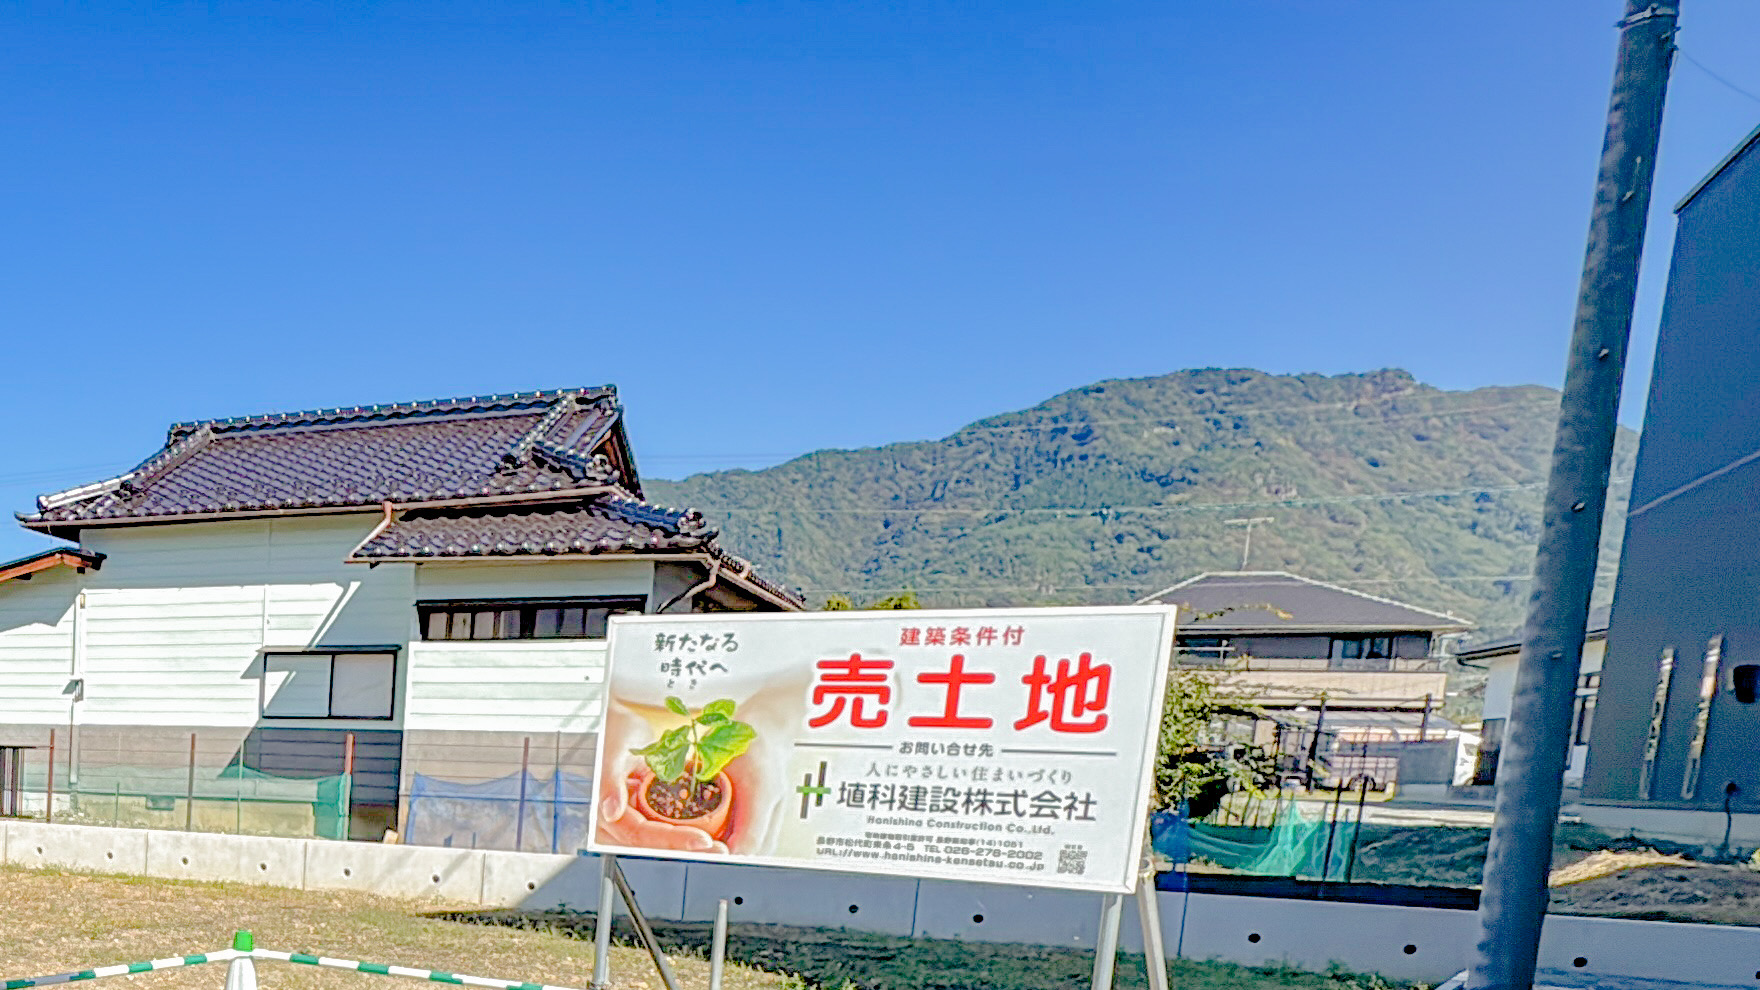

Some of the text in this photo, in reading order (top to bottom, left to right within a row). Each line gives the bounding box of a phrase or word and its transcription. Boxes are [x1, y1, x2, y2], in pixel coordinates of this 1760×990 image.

[654, 632, 739, 653] 新たなる
[900, 626, 1025, 646] 建築条件付
[660, 657, 729, 677] 時代へ
[808, 652, 1113, 733] 売土地
[898, 741, 994, 758] お問い合せ先
[865, 761, 1073, 785] 人にやさしい住まいづくり
[836, 780, 1098, 822] 埴科建設株式会社
[866, 815, 923, 828] Hanishina
[926, 818, 1003, 833] Construction
[924, 844, 941, 854] TEL
[943, 845, 1044, 860] 026-278-2002
